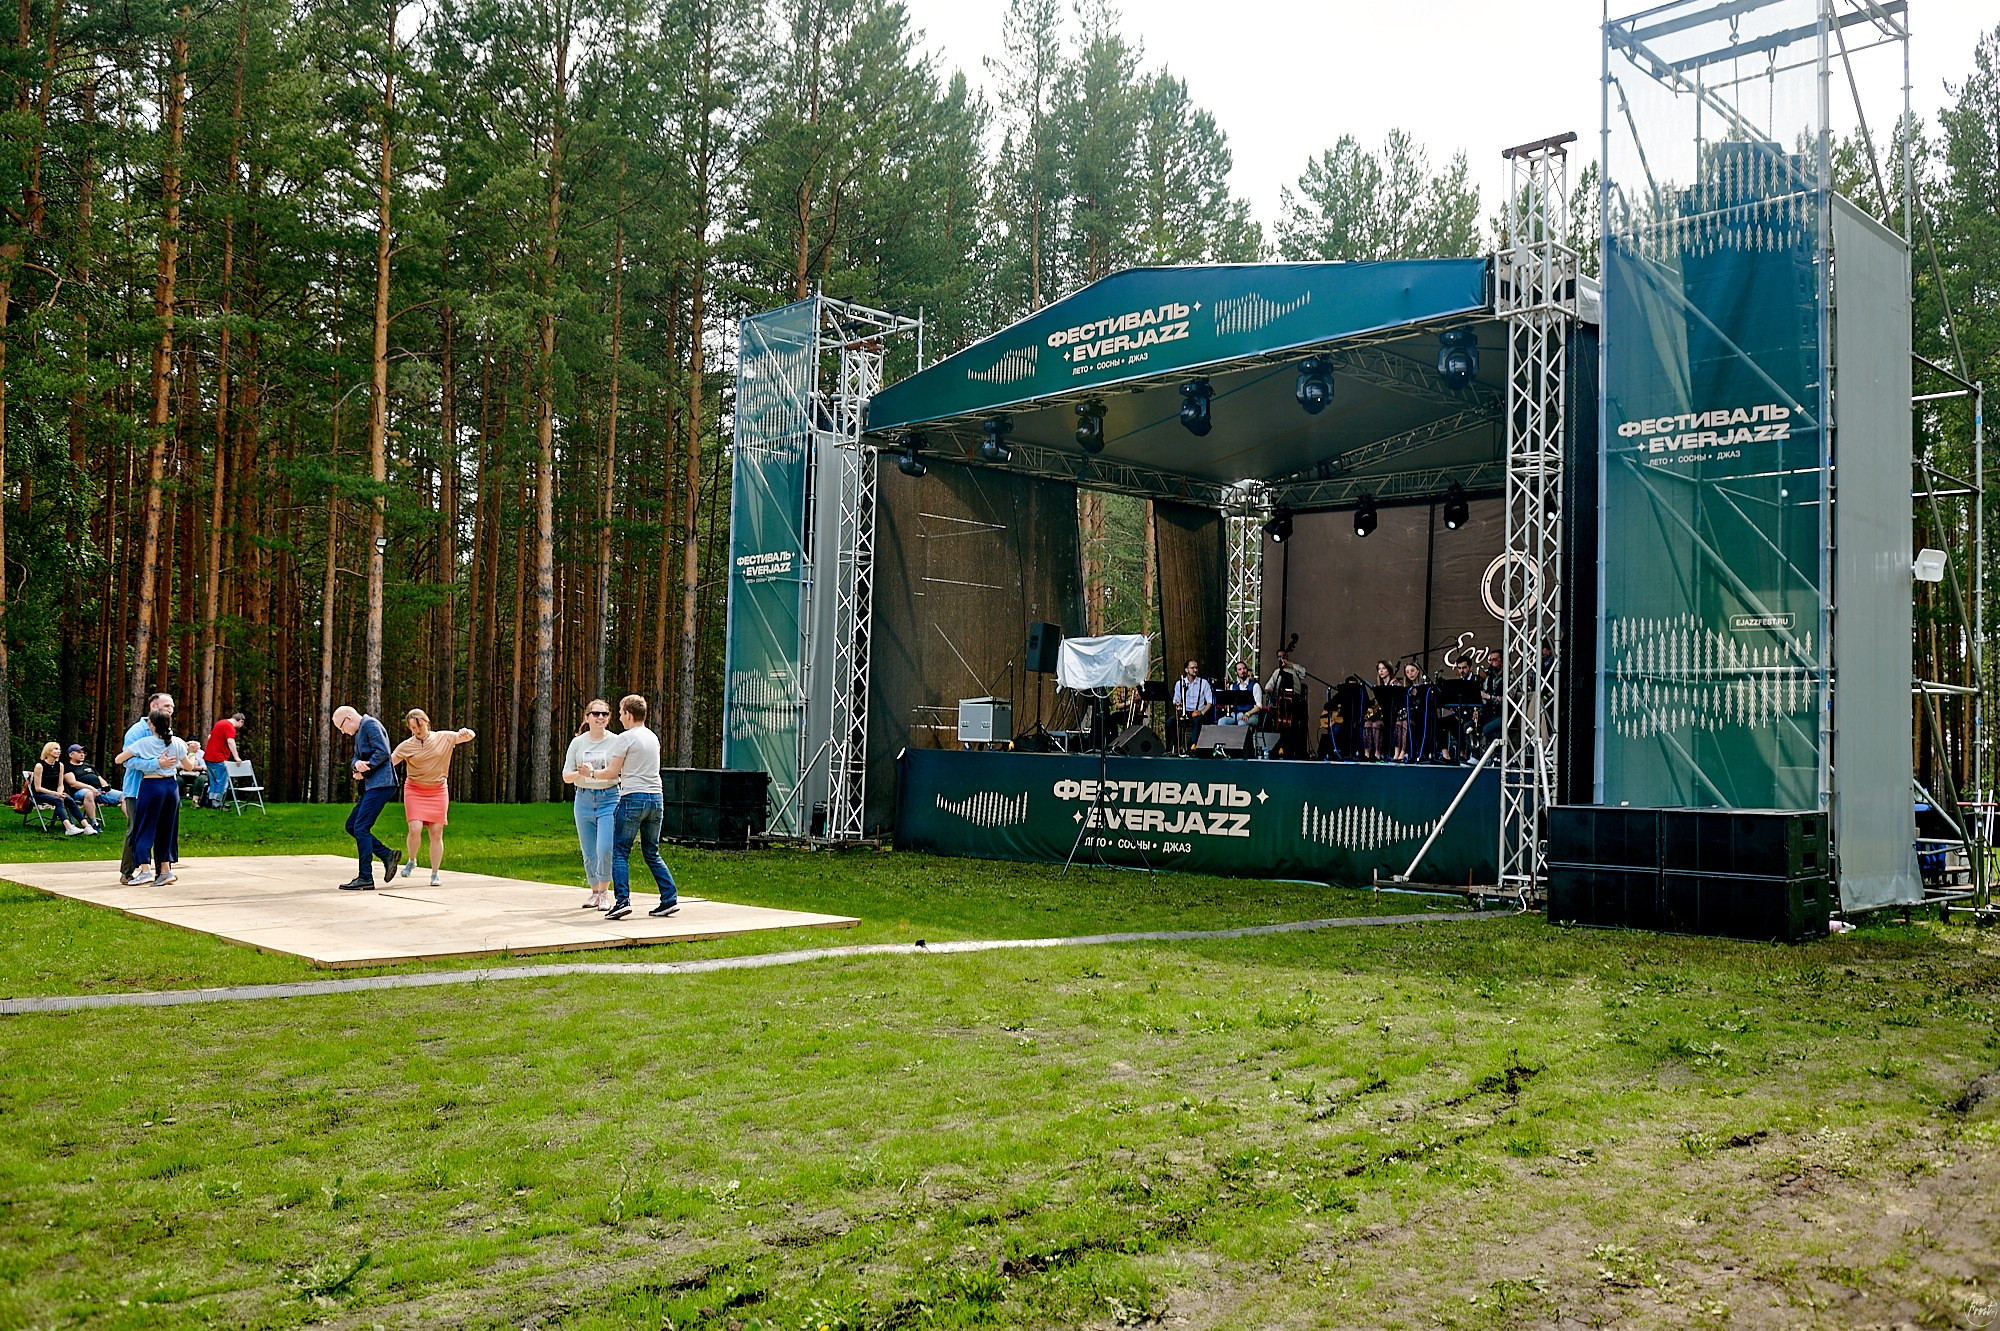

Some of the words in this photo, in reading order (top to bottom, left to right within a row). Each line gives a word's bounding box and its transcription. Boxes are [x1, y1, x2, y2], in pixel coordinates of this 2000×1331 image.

[1047, 302, 1190, 348] ФЕСТИВАЛЬ
[1073, 321, 1190, 362] EVERJAZZ
[1072, 366, 1089, 376] ЛЕТО
[1096, 359, 1121, 370] СОСНЫ
[1128, 352, 1149, 365] ДЖАЗ
[1617, 404, 1790, 438] ФЕСТИВАЛЬ
[1649, 423, 1790, 454] EVERJAZZ
[1649, 458, 1668, 467] ЛЕТО
[1678, 454, 1707, 463] СОСНЫ
[1717, 450, 1741, 460] ДЖАЗ
[736, 551, 791, 566] ФЕСТИВАЛЬ
[746, 562, 791, 576] EVERJAZZ
[1736, 618, 1788, 626] EJAZZFEST.RU
[1053, 779, 1252, 807] ФЕСТИВАЛЬ
[1086, 807, 1250, 837] EVERJAZZ
[1162, 841, 1191, 854] ДЖАЗ
